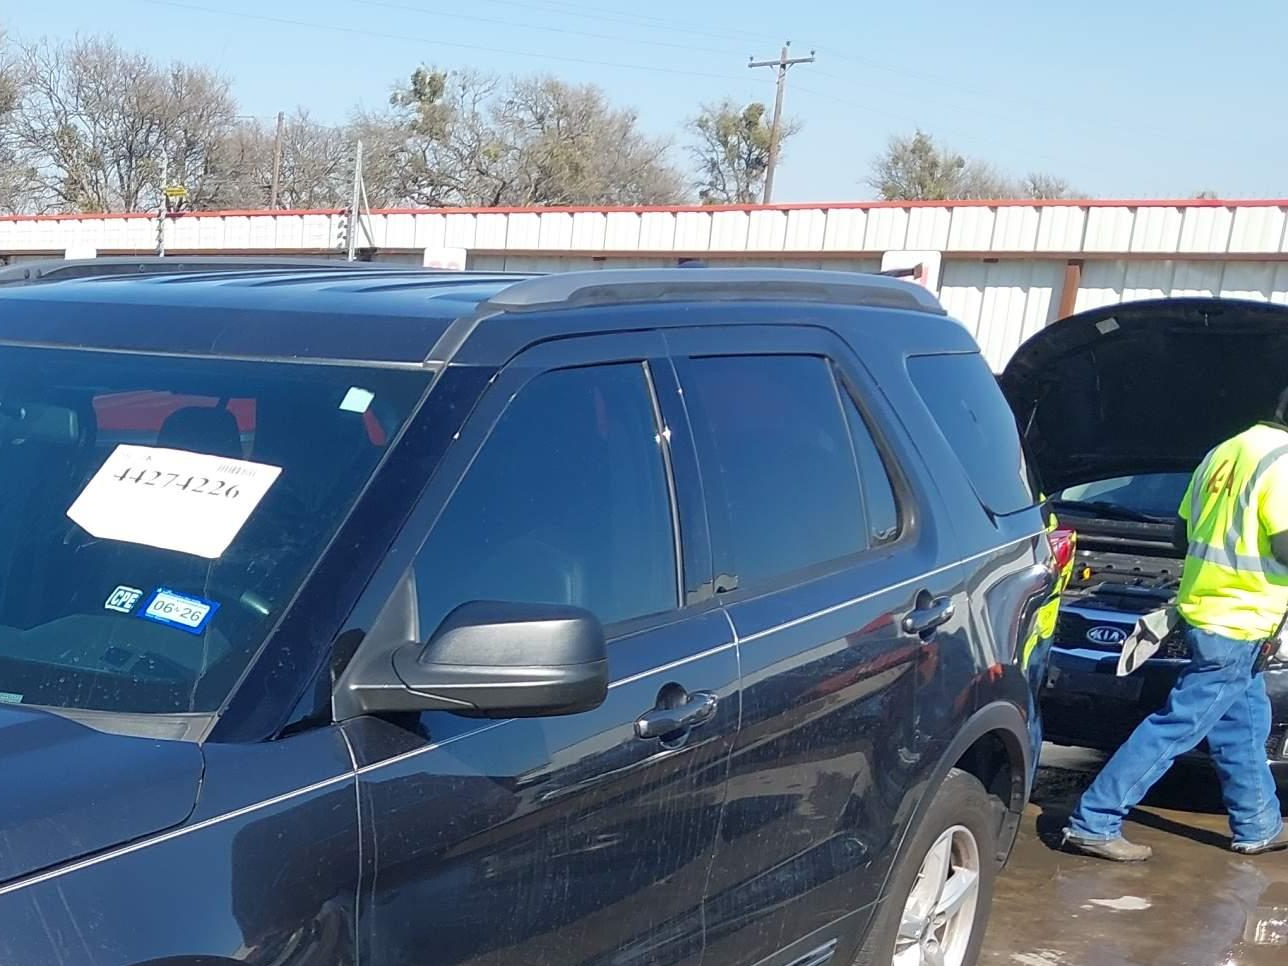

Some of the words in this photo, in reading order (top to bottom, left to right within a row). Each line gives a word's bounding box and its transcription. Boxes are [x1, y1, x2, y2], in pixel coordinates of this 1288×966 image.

[113, 467, 240, 499] 44274226
[111, 590, 140, 610] CPE
[153, 600, 175, 614] 06
[180, 607, 203, 622] 26
[1090, 629, 1120, 641] KIA
